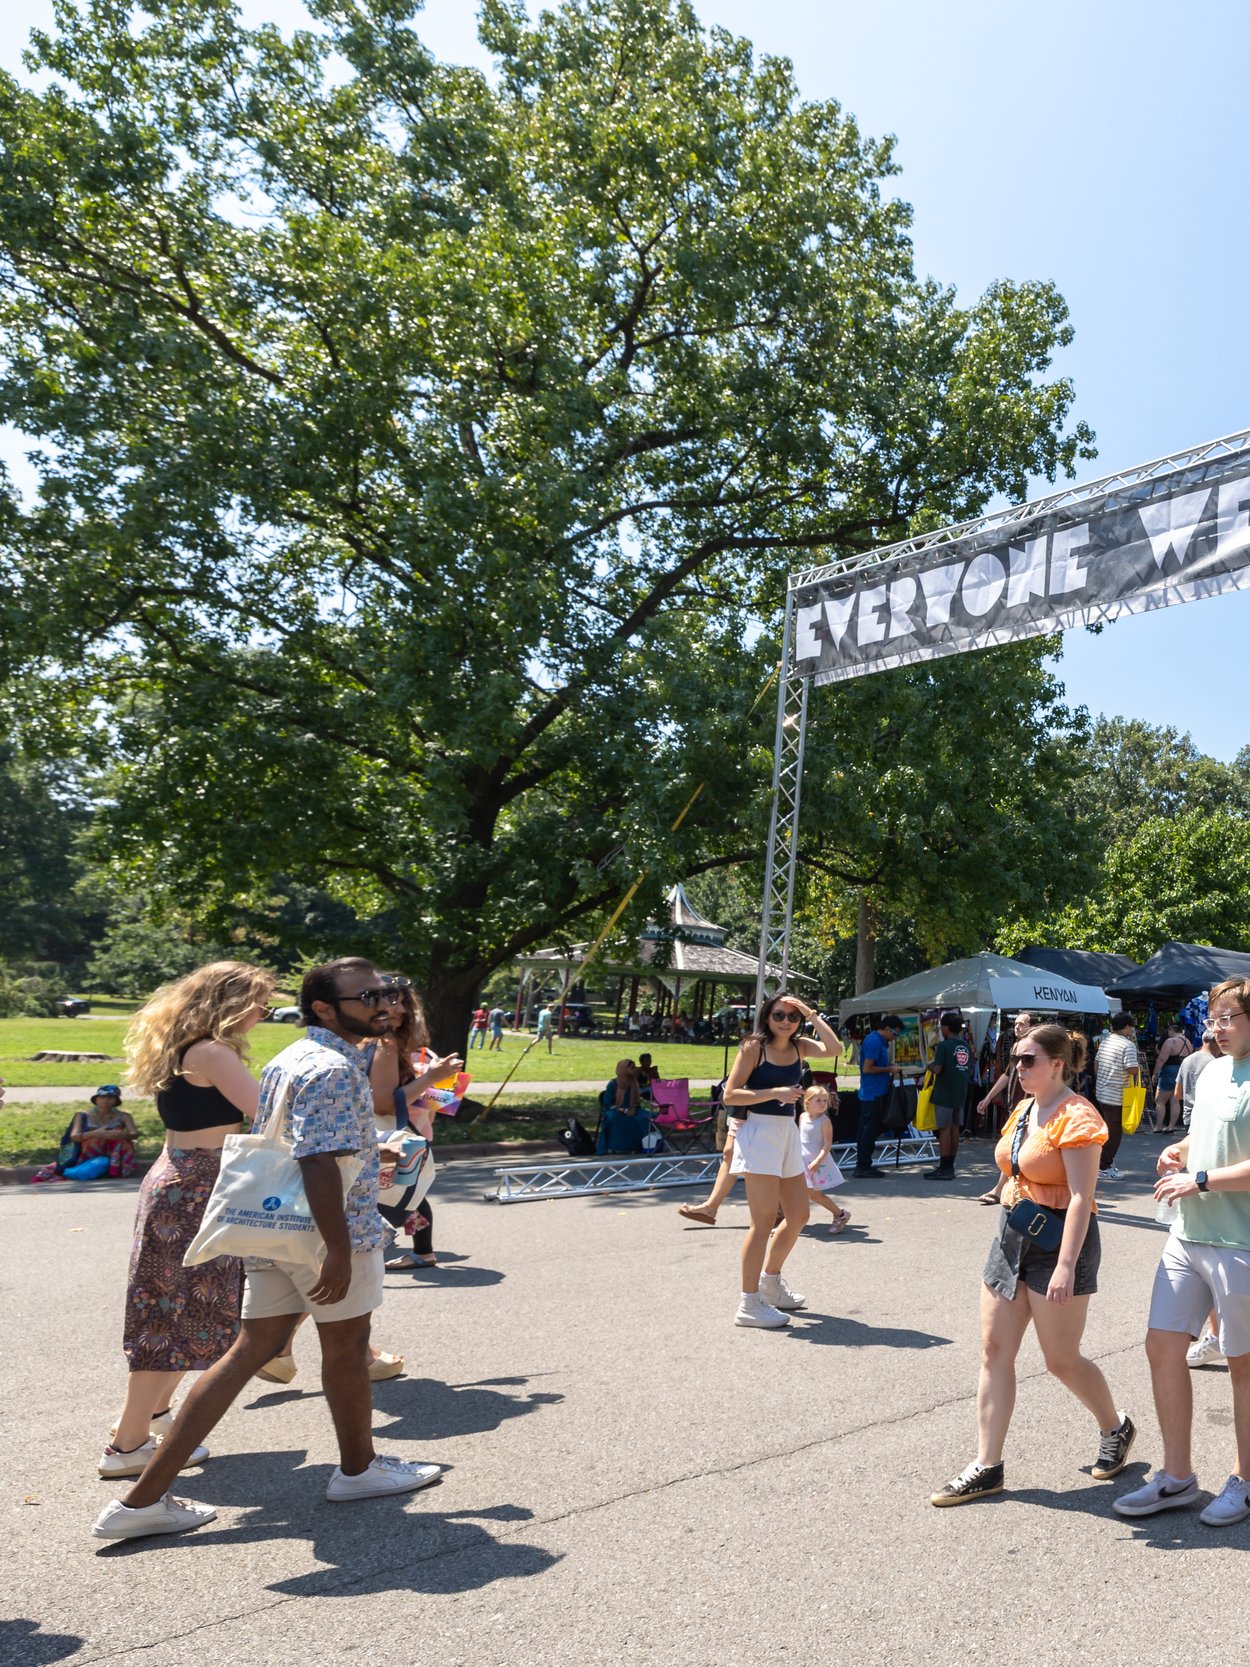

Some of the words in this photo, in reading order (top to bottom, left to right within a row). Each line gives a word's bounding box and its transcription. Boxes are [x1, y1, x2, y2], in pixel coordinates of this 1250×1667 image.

[796, 522, 1090, 661] EVERYONE
[1033, 986, 1078, 1003] KENYAN
[217, 1215, 225, 1223] OF
[225, 1216, 277, 1229] ARCHITECTURE
[278, 1222, 316, 1232] STUDENTS
[225, 1207, 236, 1216] THE
[238, 1209, 274, 1220] AMERICAN
[276, 1213, 312, 1224] INSTITUTE
